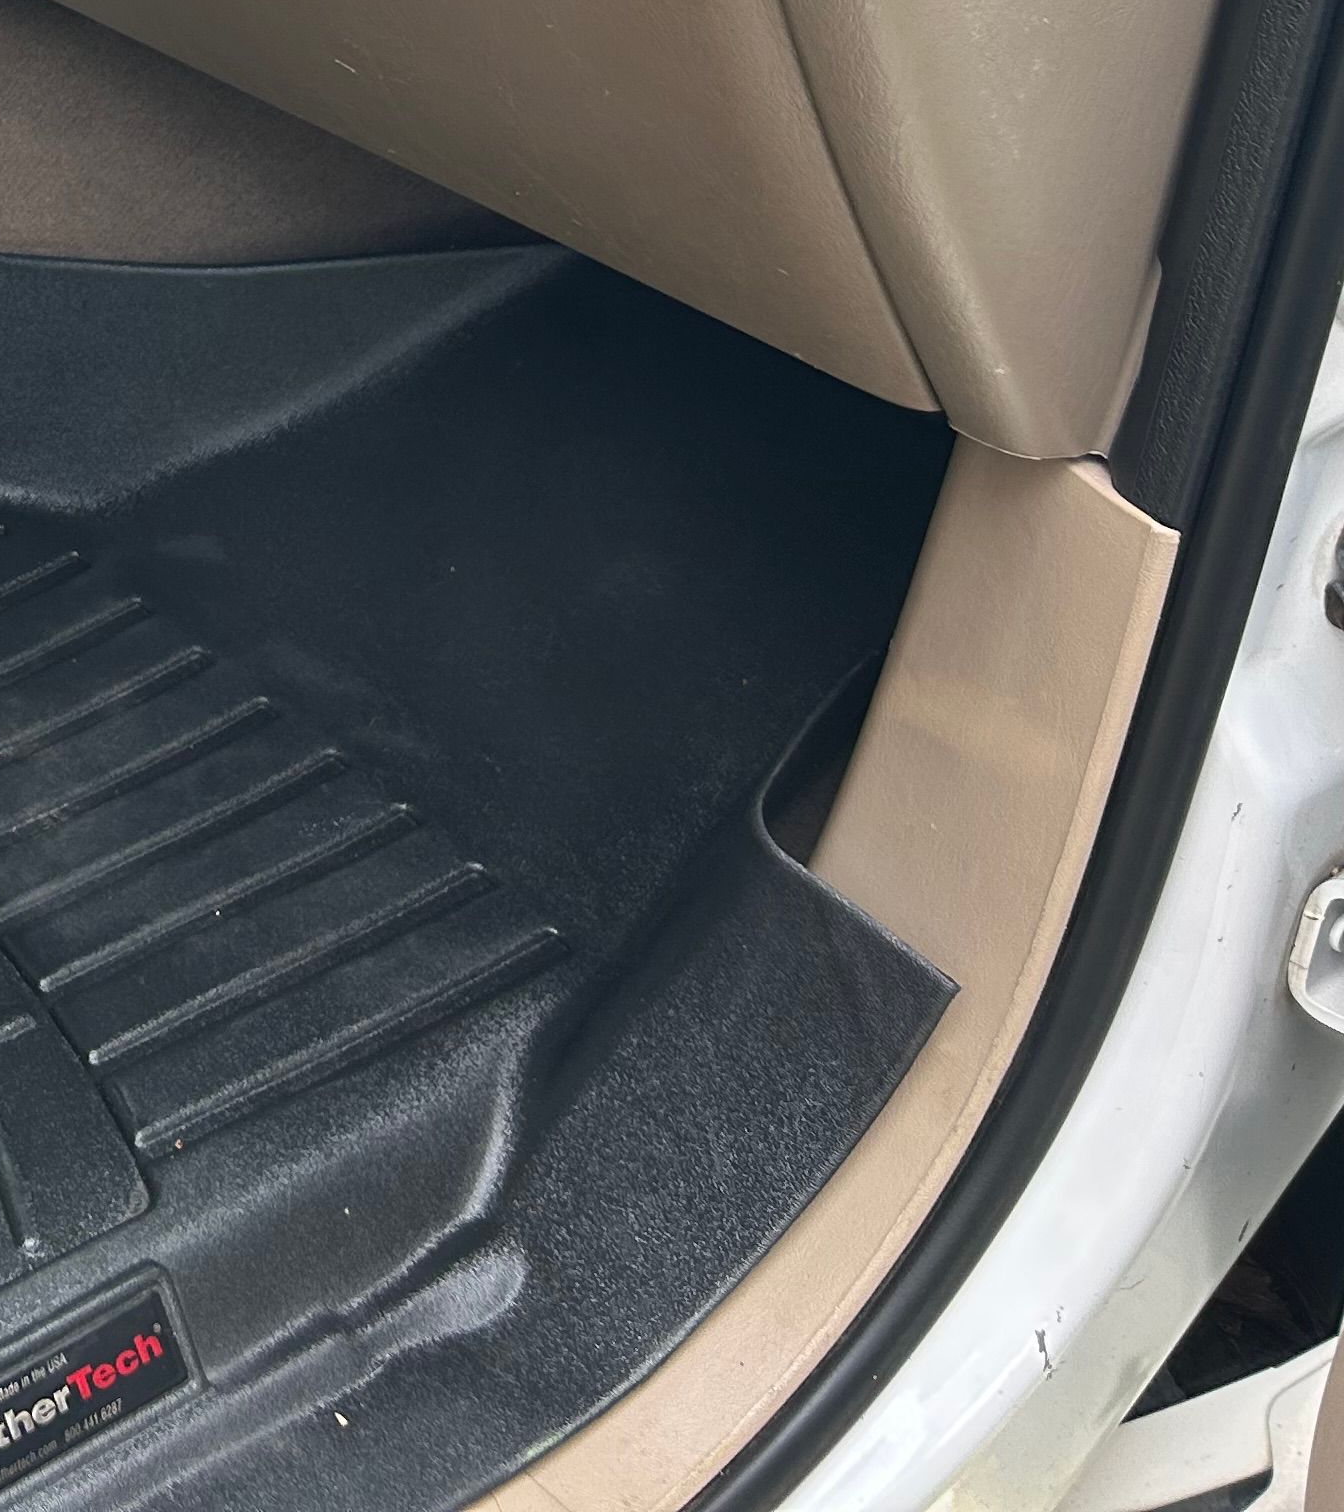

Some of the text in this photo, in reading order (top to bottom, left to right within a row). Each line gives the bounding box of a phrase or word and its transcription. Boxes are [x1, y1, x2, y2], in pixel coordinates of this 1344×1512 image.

[21, 1376, 30, 1389] in
[31, 1366, 46, 1383] the
[47, 1353, 68, 1373] USA
